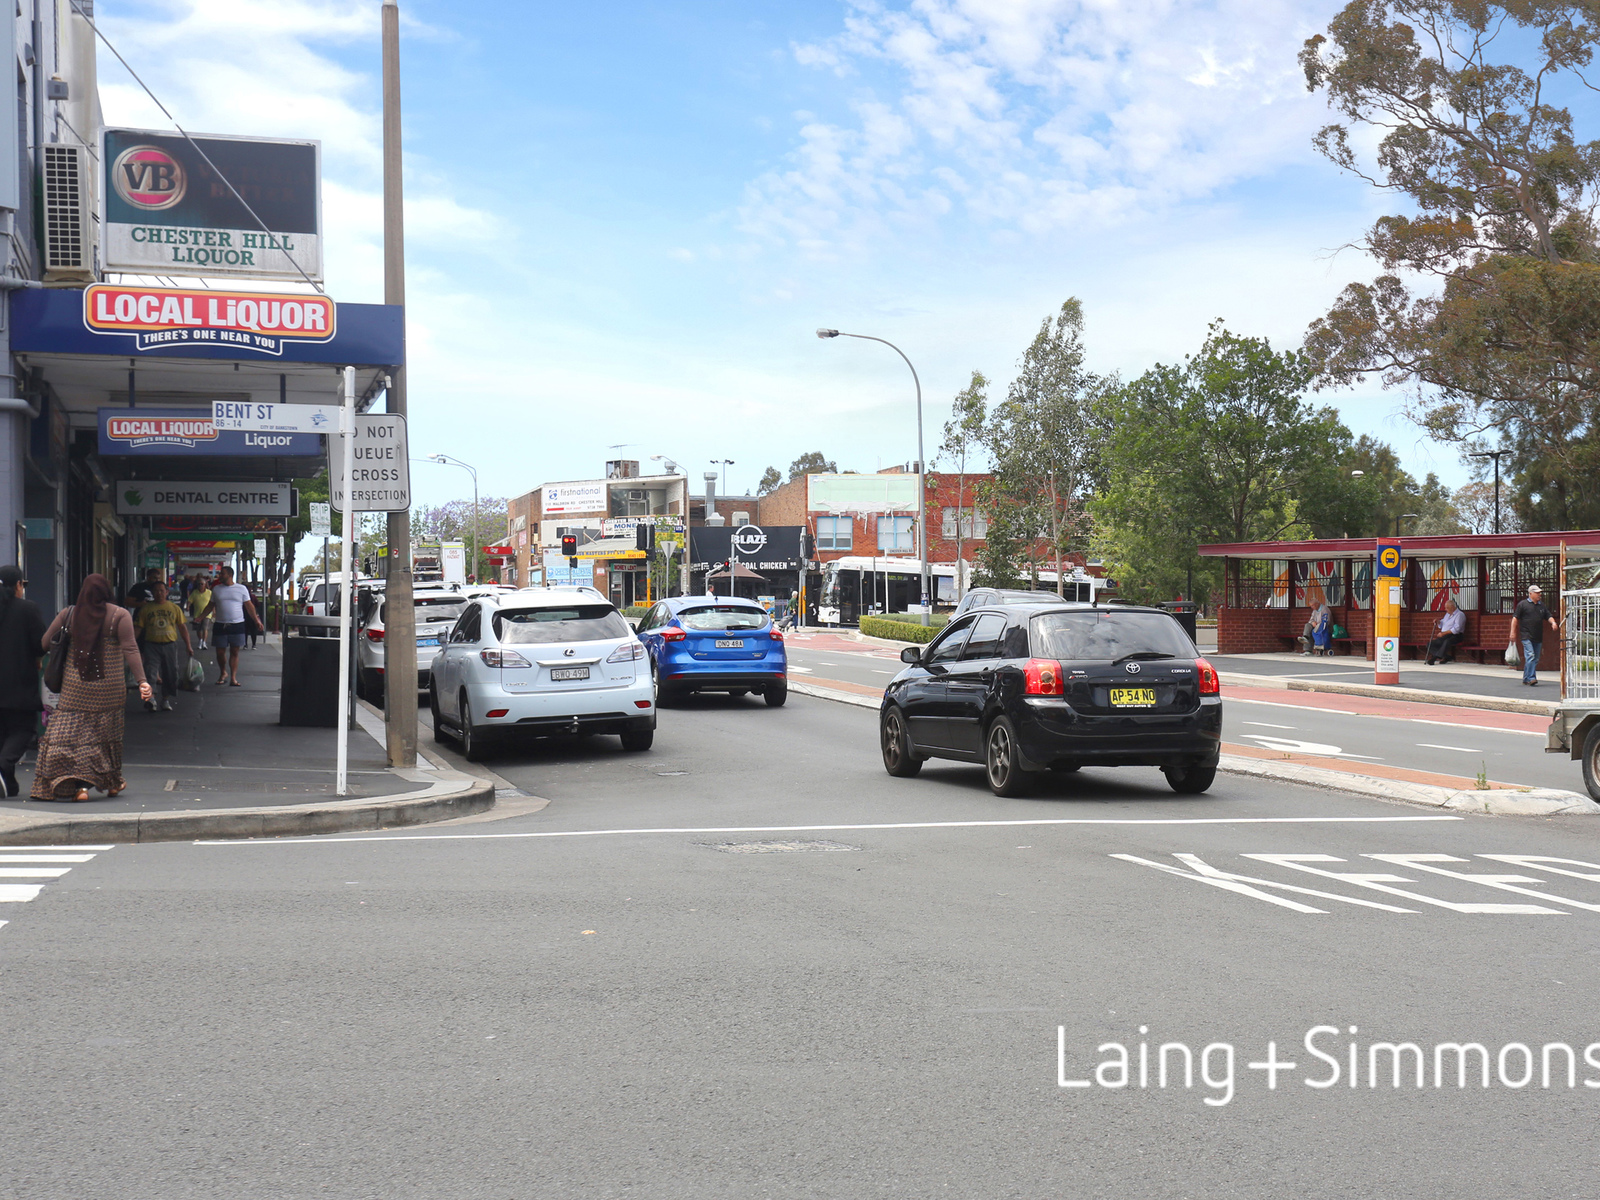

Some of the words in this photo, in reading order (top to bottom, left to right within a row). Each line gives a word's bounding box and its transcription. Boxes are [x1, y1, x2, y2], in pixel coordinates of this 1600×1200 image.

[122, 163, 177, 192] VB
[131, 227, 232, 247] CHESTER
[242, 233, 294, 250] HILL
[172, 246, 255, 266] LIQUOR
[97, 293, 202, 325] LOCAL
[143, 330, 188, 344] THERE'S
[193, 330, 216, 340] ONE
[220, 331, 250, 344] NEAR
[254, 335, 276, 349] YOU
[215, 403, 252, 419] BENT
[257, 404, 274, 420] ST
[113, 421, 162, 436] LOCAL
[215, 419, 225, 427] 86
[233, 419, 242, 428] 14
[367, 426, 395, 438] NOT
[245, 433, 292, 449] Liquor
[355, 448, 394, 460] UEUE
[341, 469, 399, 481] CROSS
[154, 491, 214, 504] DENTAL
[217, 492, 279, 504] CENTRE
[335, 490, 407, 501] INERSECTION
[733, 534, 768, 544] BLAZE
[741, 561, 758, 570] COAL
[759, 561, 788, 570] CHICKEN
